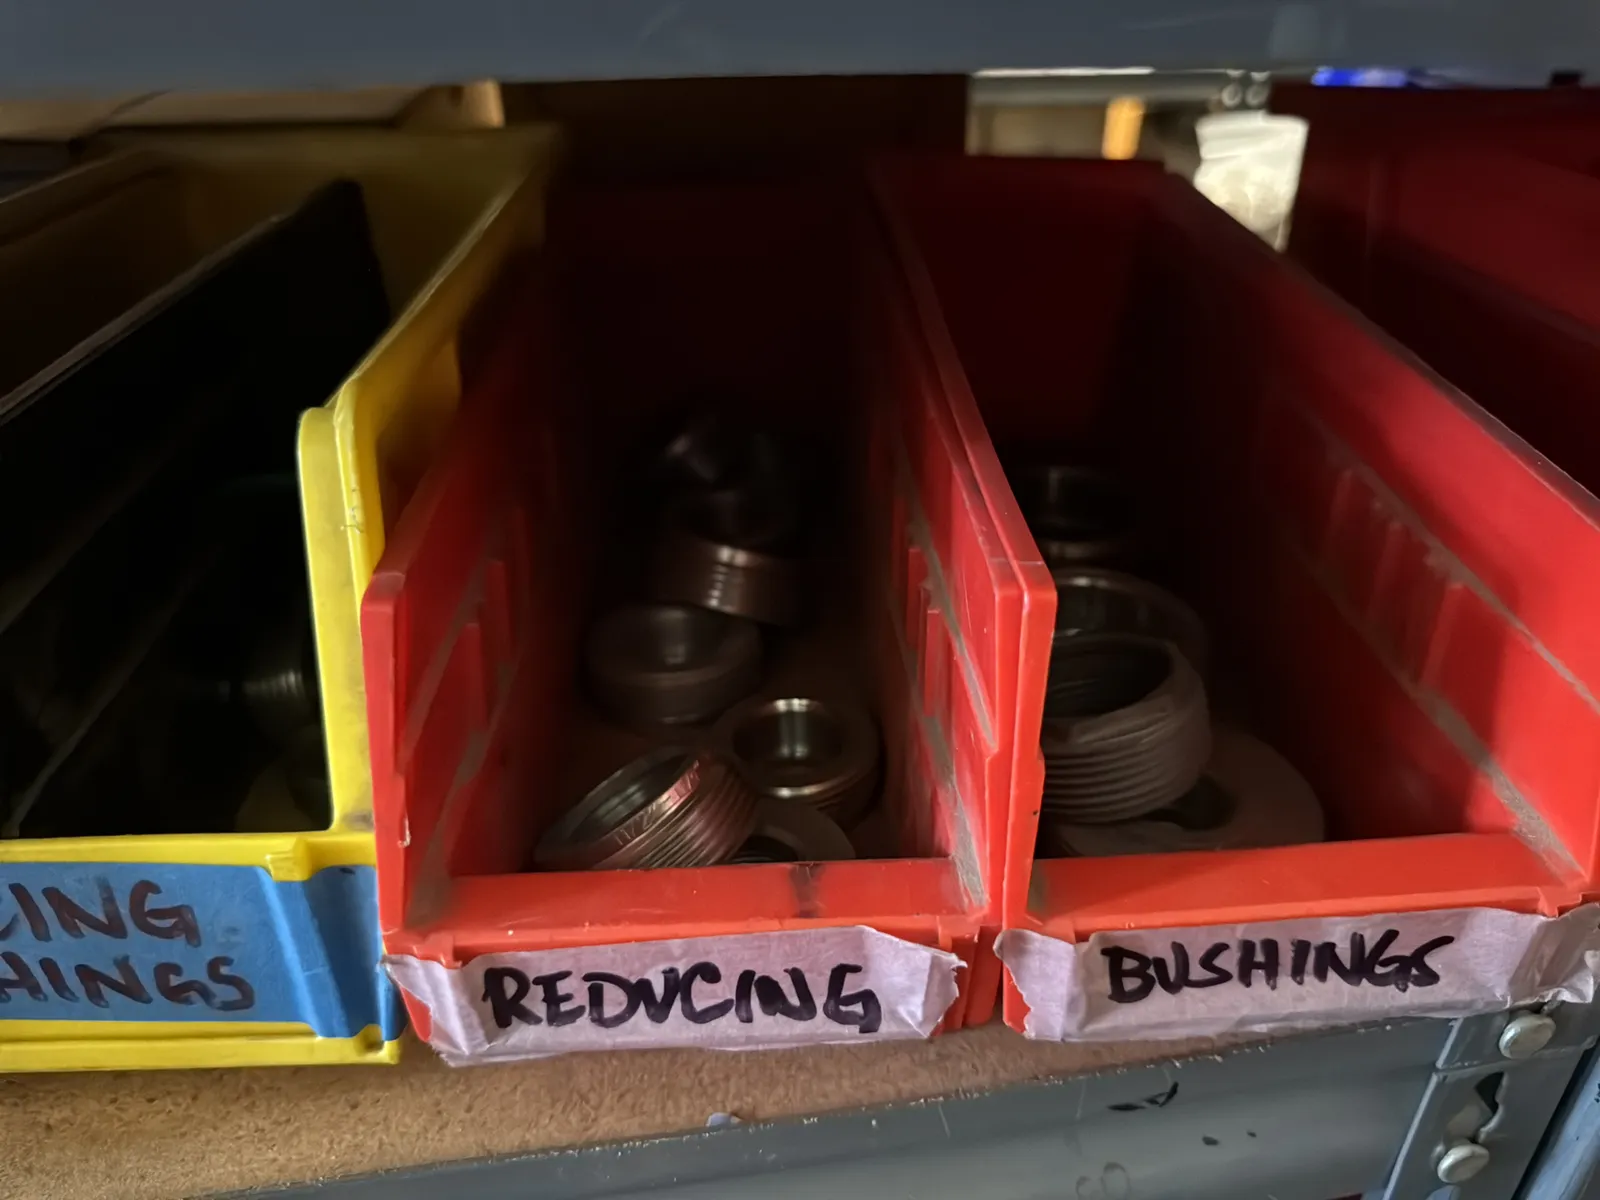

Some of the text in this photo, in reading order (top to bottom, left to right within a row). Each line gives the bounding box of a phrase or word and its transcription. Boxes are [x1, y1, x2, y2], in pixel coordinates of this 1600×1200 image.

[0, 877, 201, 948] ING
[482, 961, 882, 1034] REDUCING
[1101, 929, 1455, 1003] BUSHINGS
